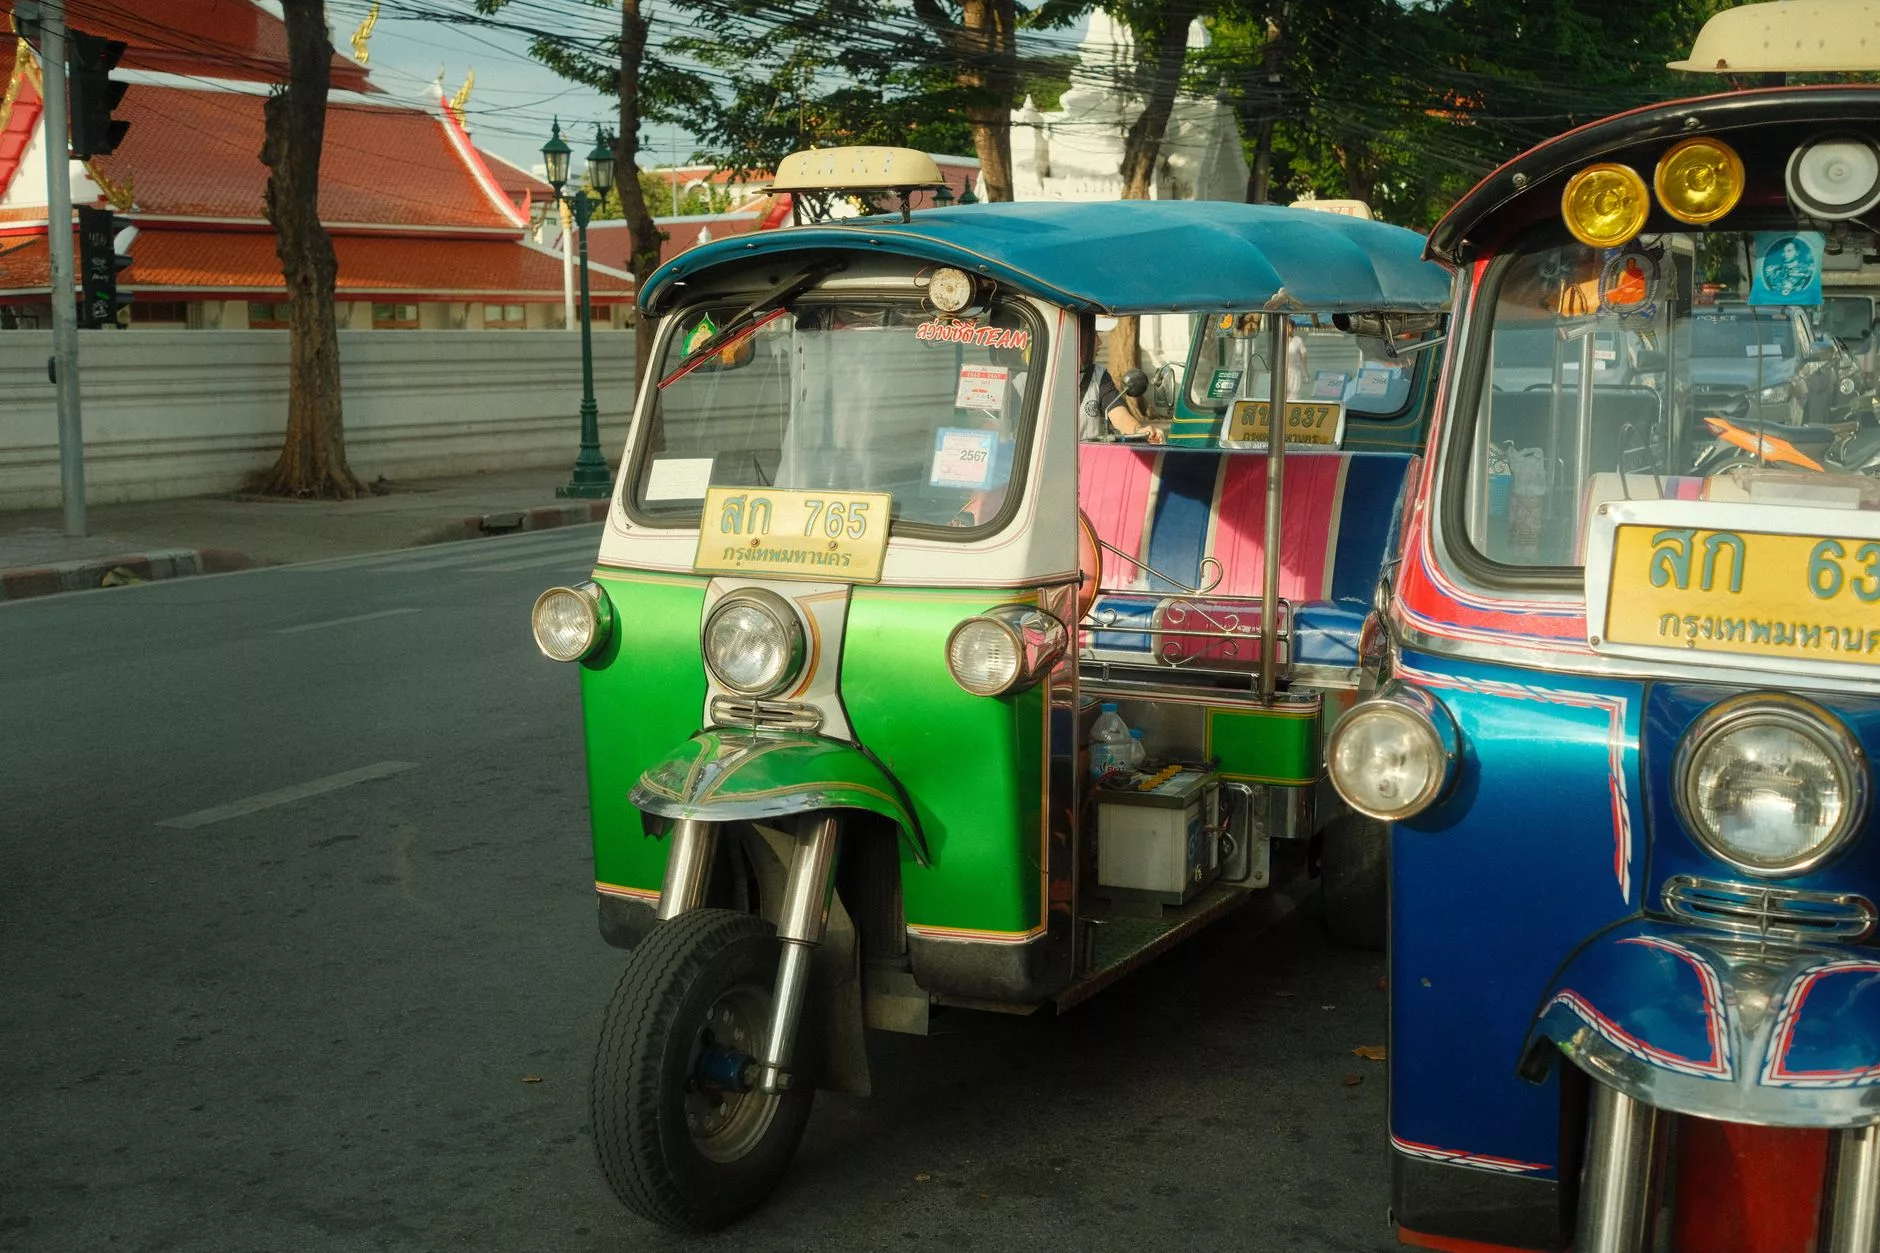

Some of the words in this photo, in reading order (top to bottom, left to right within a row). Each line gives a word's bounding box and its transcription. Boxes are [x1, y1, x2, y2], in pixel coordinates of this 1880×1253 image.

[975, 326, 1028, 350] TEAM
[1289, 407, 1329, 428] 837
[960, 449, 988, 463] 2567
[721, 494, 772, 535] สก
[804, 499, 868, 539] 765
[723, 546, 852, 568] กรุงเทพมหานคร
[1650, 527, 1746, 594] สก
